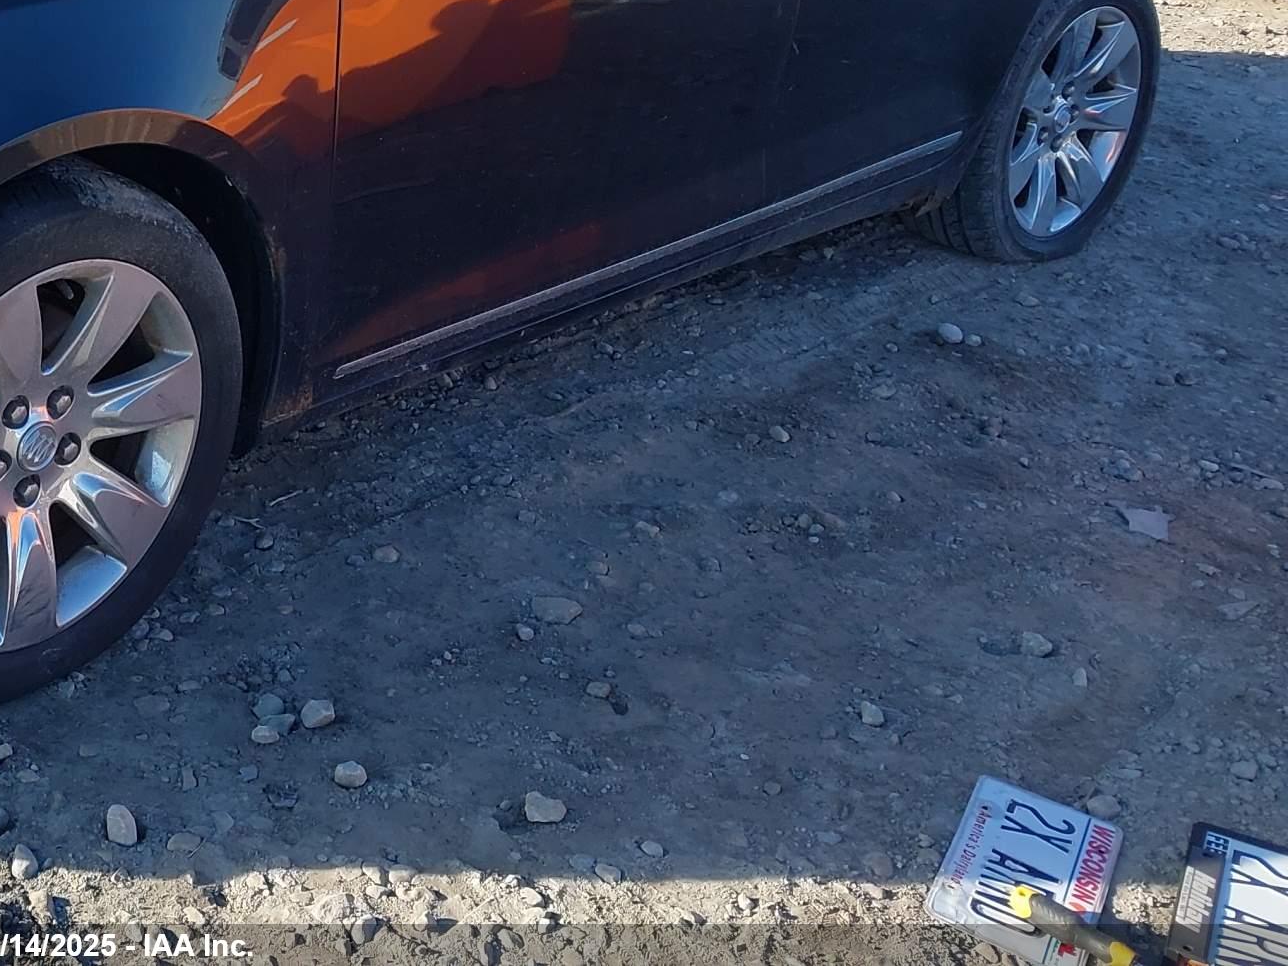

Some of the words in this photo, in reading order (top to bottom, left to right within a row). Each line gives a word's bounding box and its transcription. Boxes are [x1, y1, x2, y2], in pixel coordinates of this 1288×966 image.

[964, 808, 993, 850] America's
[1000, 799, 1076, 854] 2X
[951, 849, 976, 884] Dairyland
[1072, 824, 1116, 906] WISCONSIN
